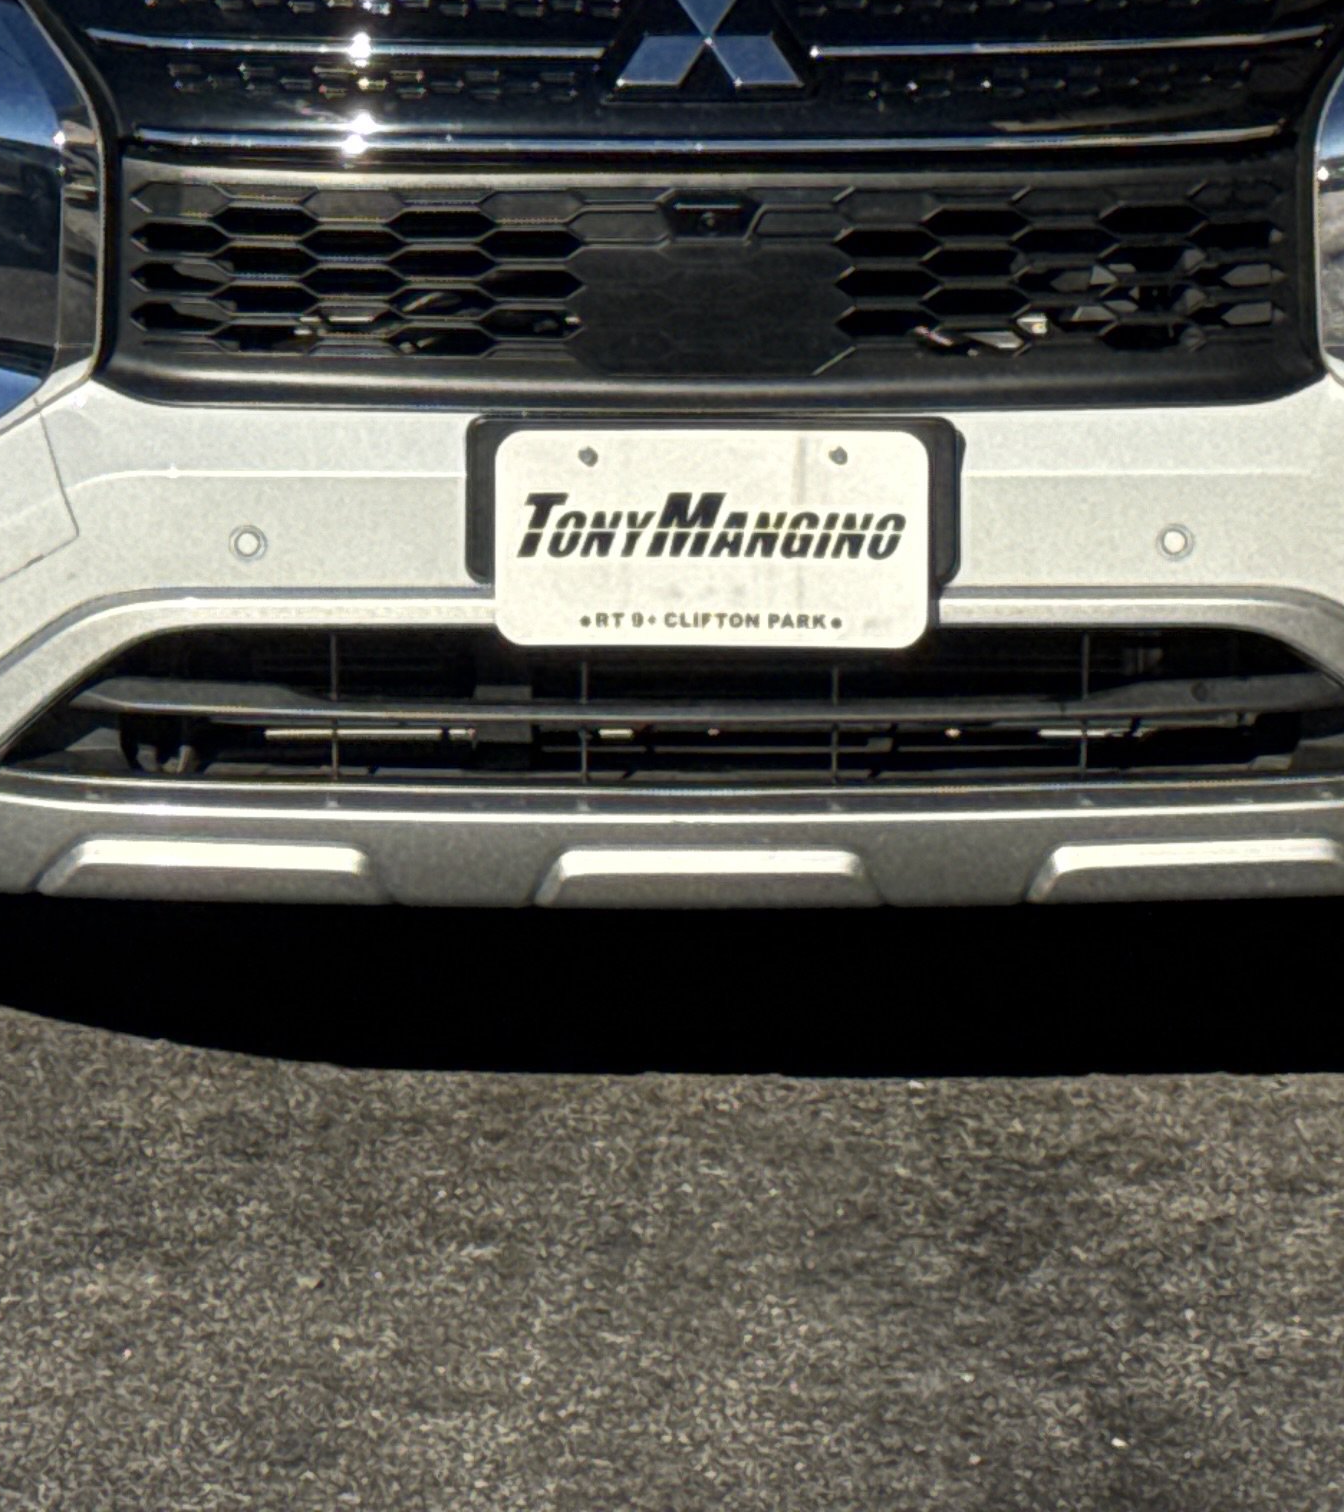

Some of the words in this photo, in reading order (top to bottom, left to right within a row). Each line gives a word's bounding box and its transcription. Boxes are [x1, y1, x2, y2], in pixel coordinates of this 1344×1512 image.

[595, 612, 625, 628] RT
[663, 612, 760, 628] CLIFTON
[767, 614, 826, 629] PARK
